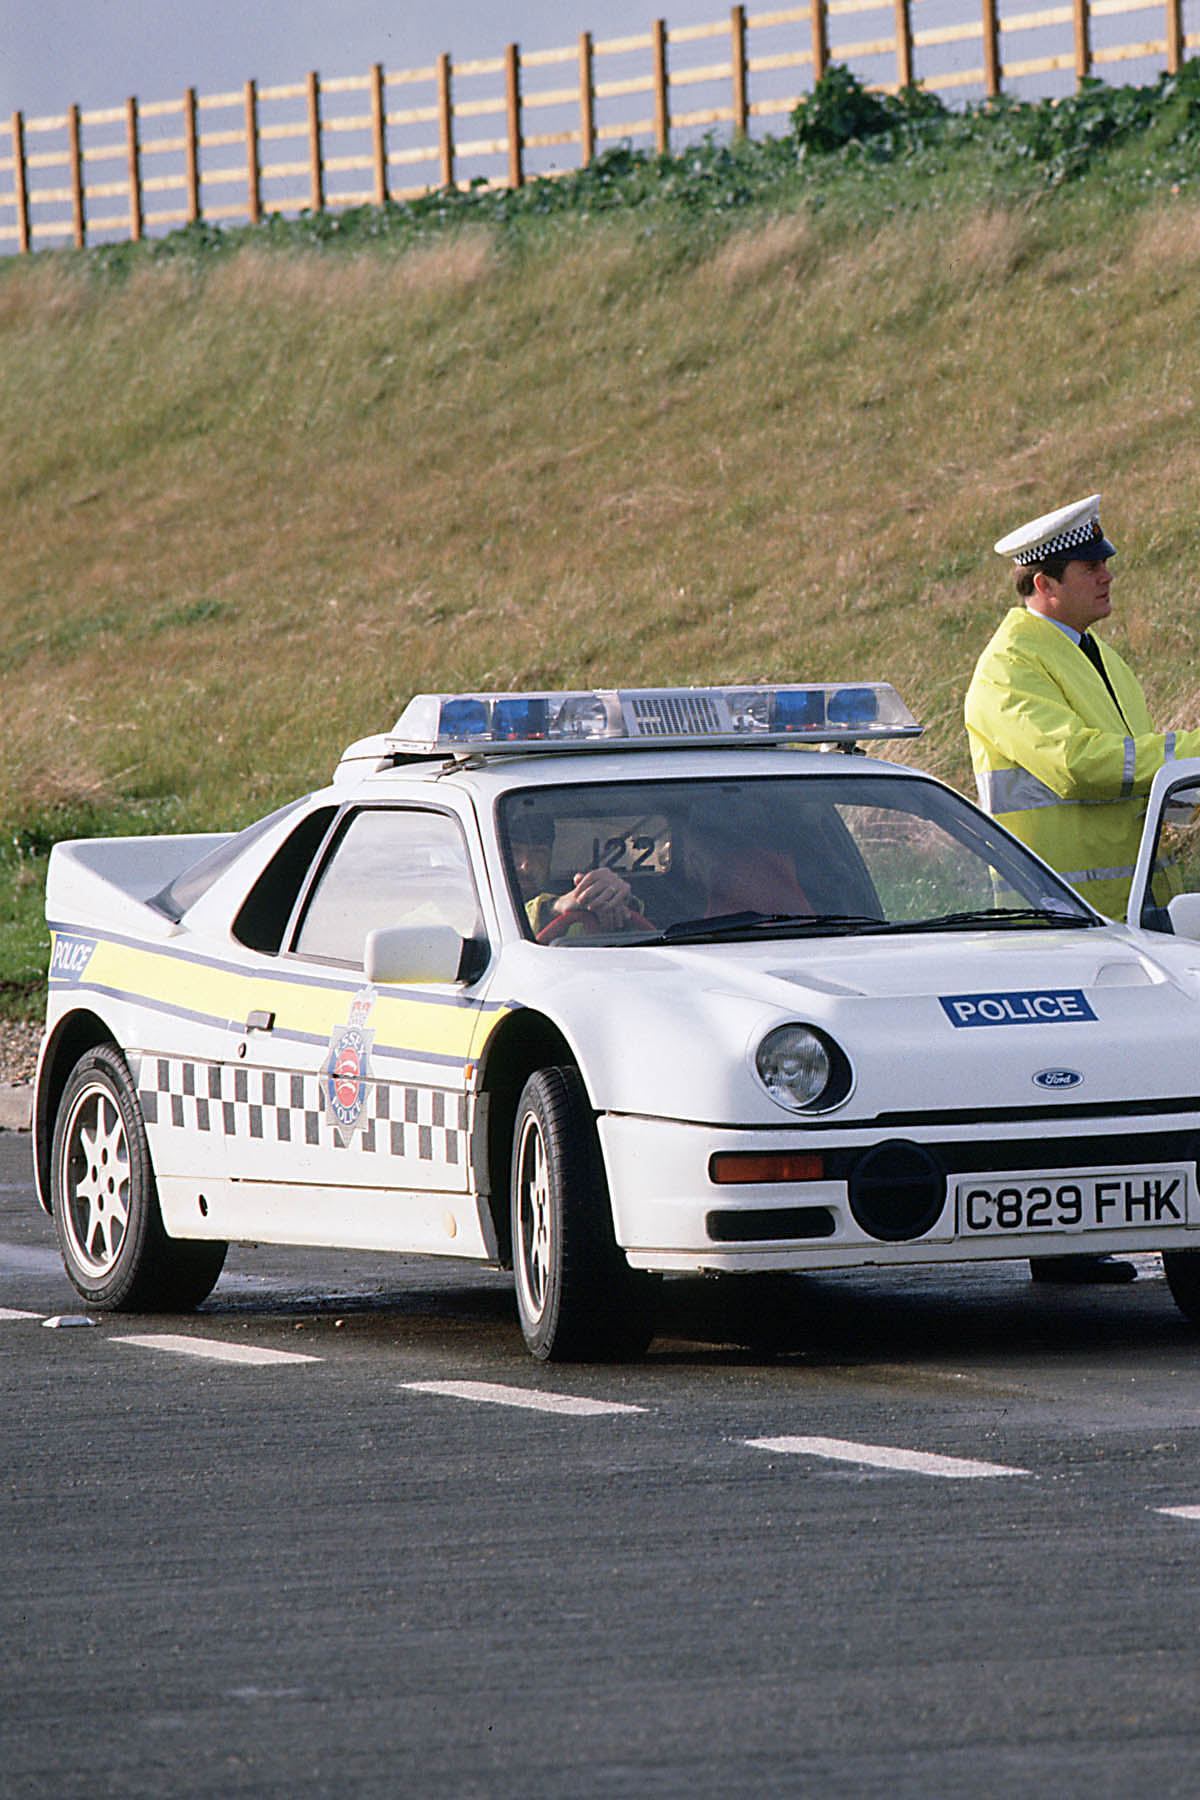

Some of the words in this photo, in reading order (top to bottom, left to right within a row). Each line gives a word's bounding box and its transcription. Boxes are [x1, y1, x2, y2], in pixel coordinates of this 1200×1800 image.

[53, 940, 92, 971] POLICE
[952, 996, 1084, 1021] POLICE
[966, 1185, 1083, 1230] C829
[1094, 1178, 1182, 1224] FHK
